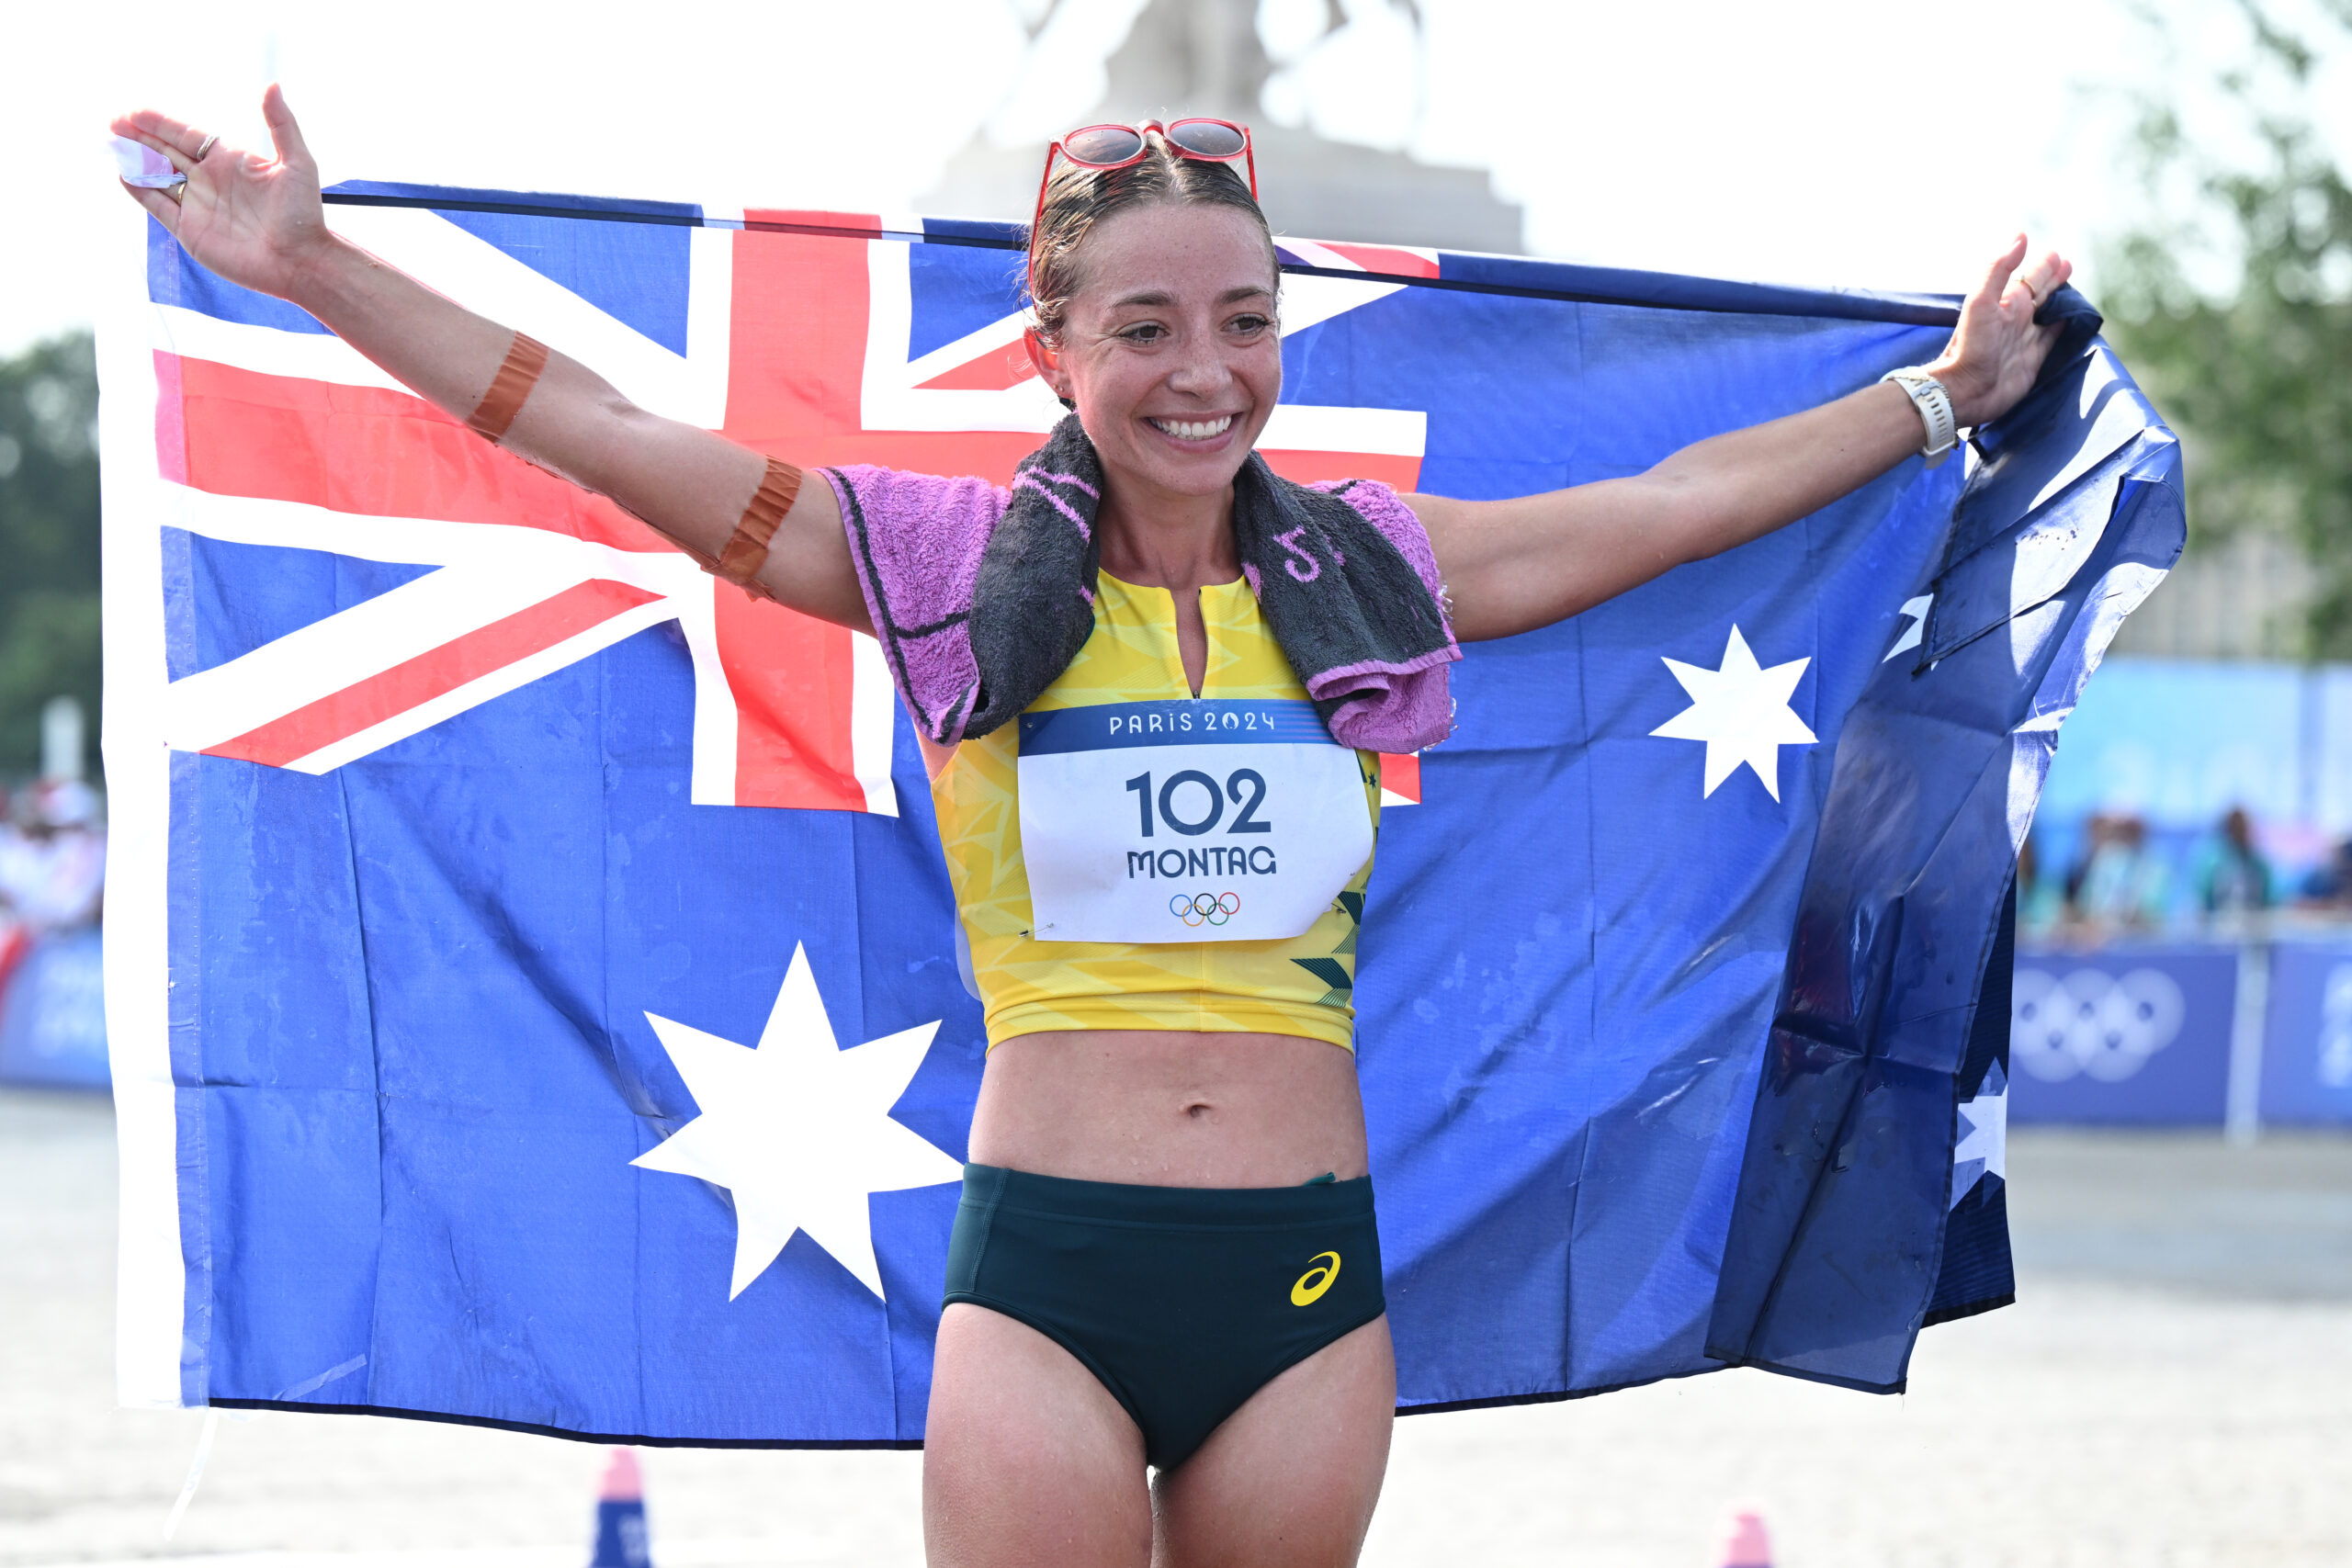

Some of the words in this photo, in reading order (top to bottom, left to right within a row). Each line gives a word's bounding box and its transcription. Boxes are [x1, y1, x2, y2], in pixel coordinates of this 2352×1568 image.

[1204, 711, 1275, 731] 2024
[1125, 768, 1272, 837] 102
[1126, 845, 1277, 879] MONTAG
